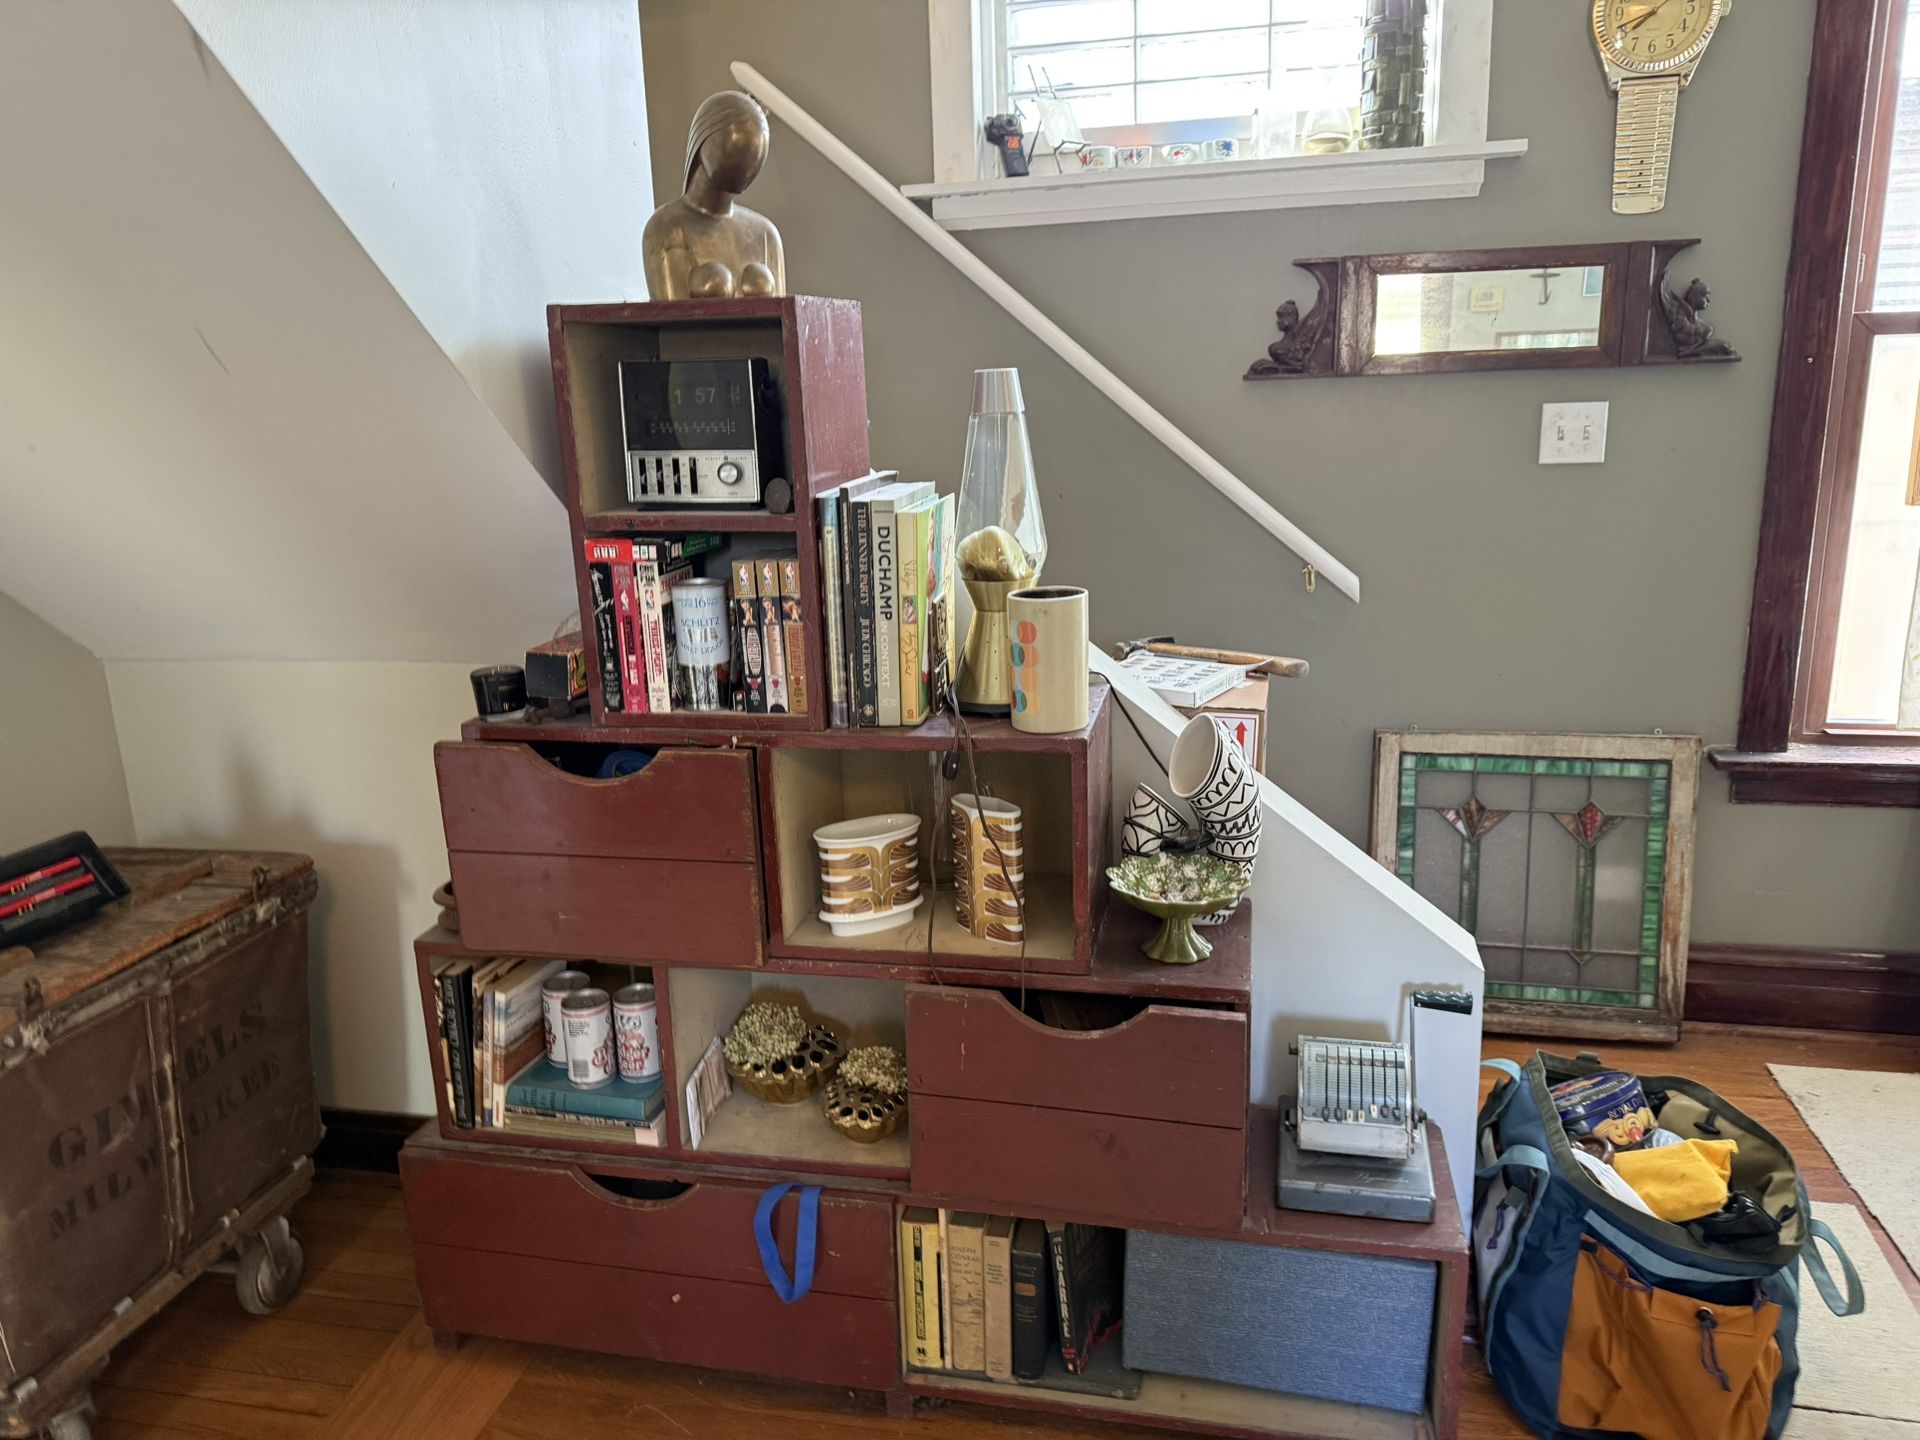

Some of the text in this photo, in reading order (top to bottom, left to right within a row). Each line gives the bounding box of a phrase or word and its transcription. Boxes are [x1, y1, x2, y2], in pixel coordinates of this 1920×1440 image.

[1615, 6, 1624, 21] 9
[1677, 17, 1689, 33] 4
[1631, 37, 1640, 52] 7
[1647, 39, 1657, 54] 6
[1665, 33, 1674, 48] 5
[857, 506, 870, 607] THE DINNER PARTY
[694, 597, 707, 609] 16
[877, 525, 893, 688] DUCHAMP IN CONTEXT
[680, 616, 720, 628] SCHLITZ
[680, 638, 724, 655] MALT LIQUOR
[859, 617, 873, 688] JUDY CHICAGO
[1607, 1103, 1635, 1120] ROYAL
